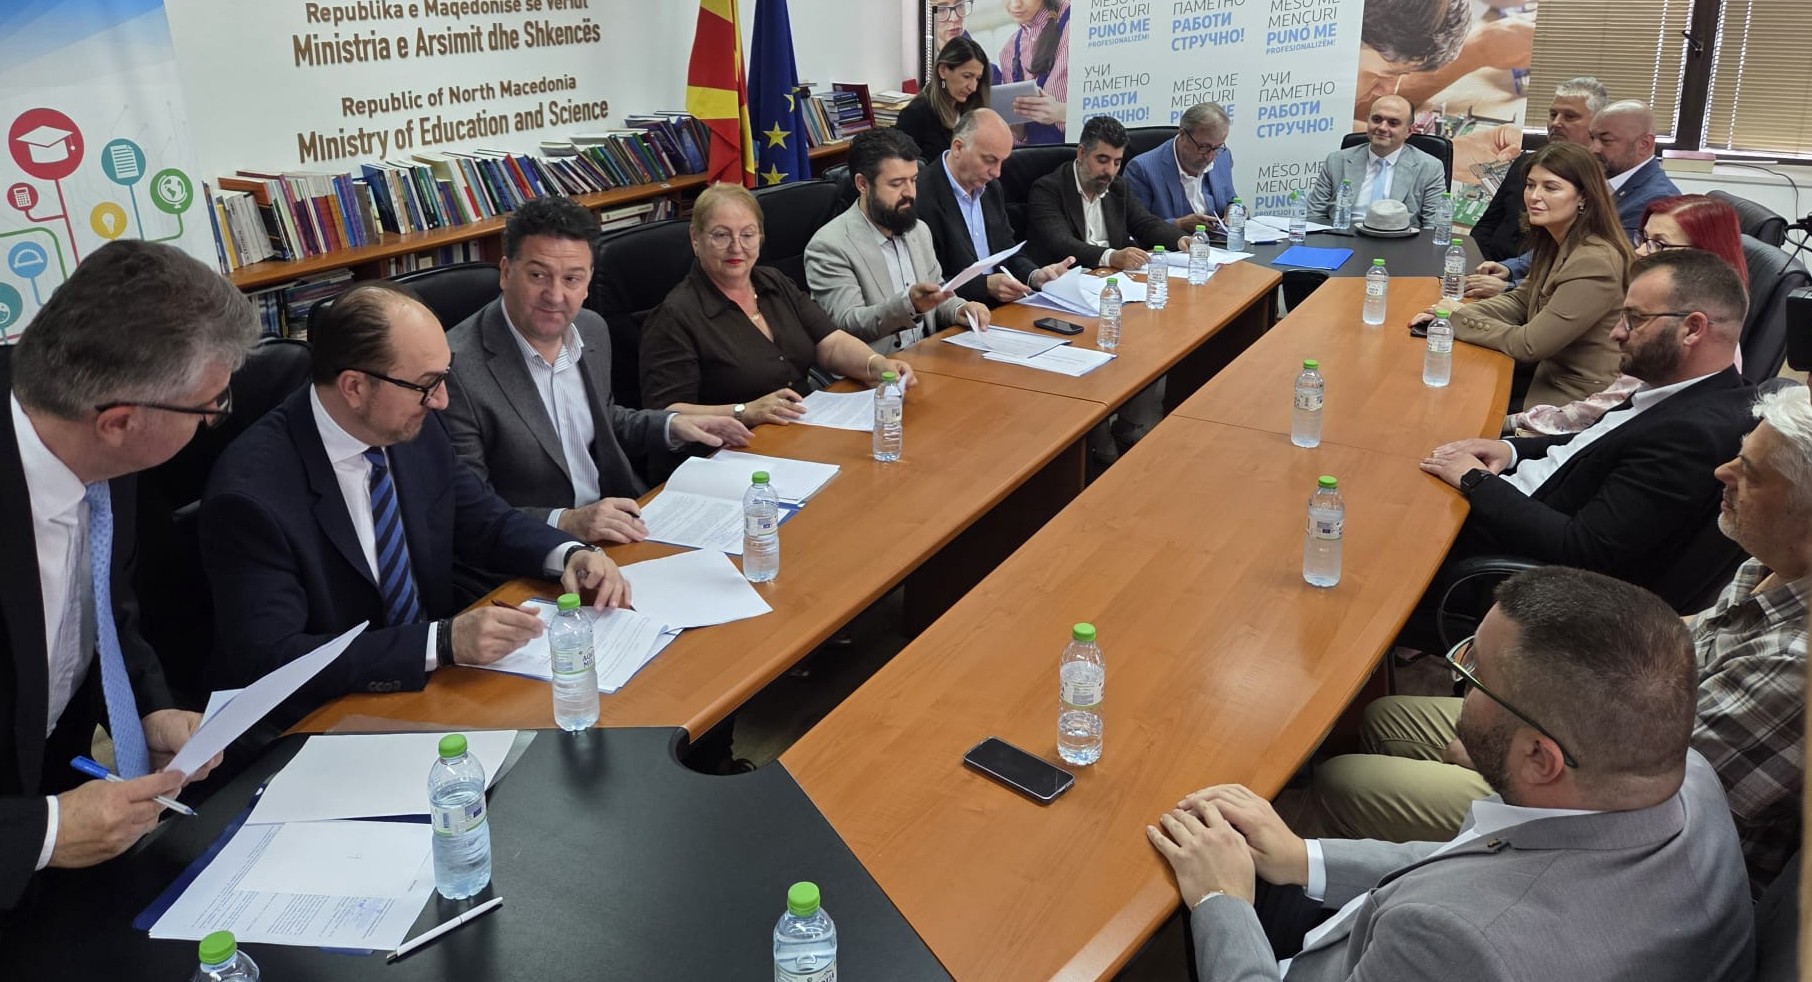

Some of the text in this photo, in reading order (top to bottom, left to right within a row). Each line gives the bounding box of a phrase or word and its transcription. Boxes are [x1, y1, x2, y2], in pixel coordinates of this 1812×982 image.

[305, 0, 404, 26] Republika
[408, 3, 419, 18] e
[1089, 2, 1150, 24] MENÇURI
[1172, 12, 1232, 33] РАБОТИ
[1268, 6, 1337, 29] MENÇURI
[1129, 18, 1150, 33] ME
[1313, 22, 1338, 39] ME
[292, 18, 601, 67] Ministria e Arsimit dhe Shkencës
[1171, 28, 1245, 51] СТРУЧНО!
[1084, 63, 1111, 78] УЧИ
[1261, 70, 1291, 87] УЧИ
[1083, 72, 1151, 93] ПАМЕТНО
[1172, 72, 1239, 93] MËSO ME
[1258, 81, 1336, 102] ПАМЕТНО
[341, 74, 577, 118] Republic of North Macedonia
[1082, 90, 1138, 110] РАБОТИ
[1082, 106, 1149, 125] СЧНО!
[1257, 100, 1321, 120] РАБОТИ
[394, 119, 414, 150] of
[419, 109, 509, 146] Education
[514, 102, 545, 132] and
[549, 99, 609, 127] Science
[1256, 116, 1334, 138] СТРУЧНО!
[1258, 161, 1325, 179] MËSO ME
